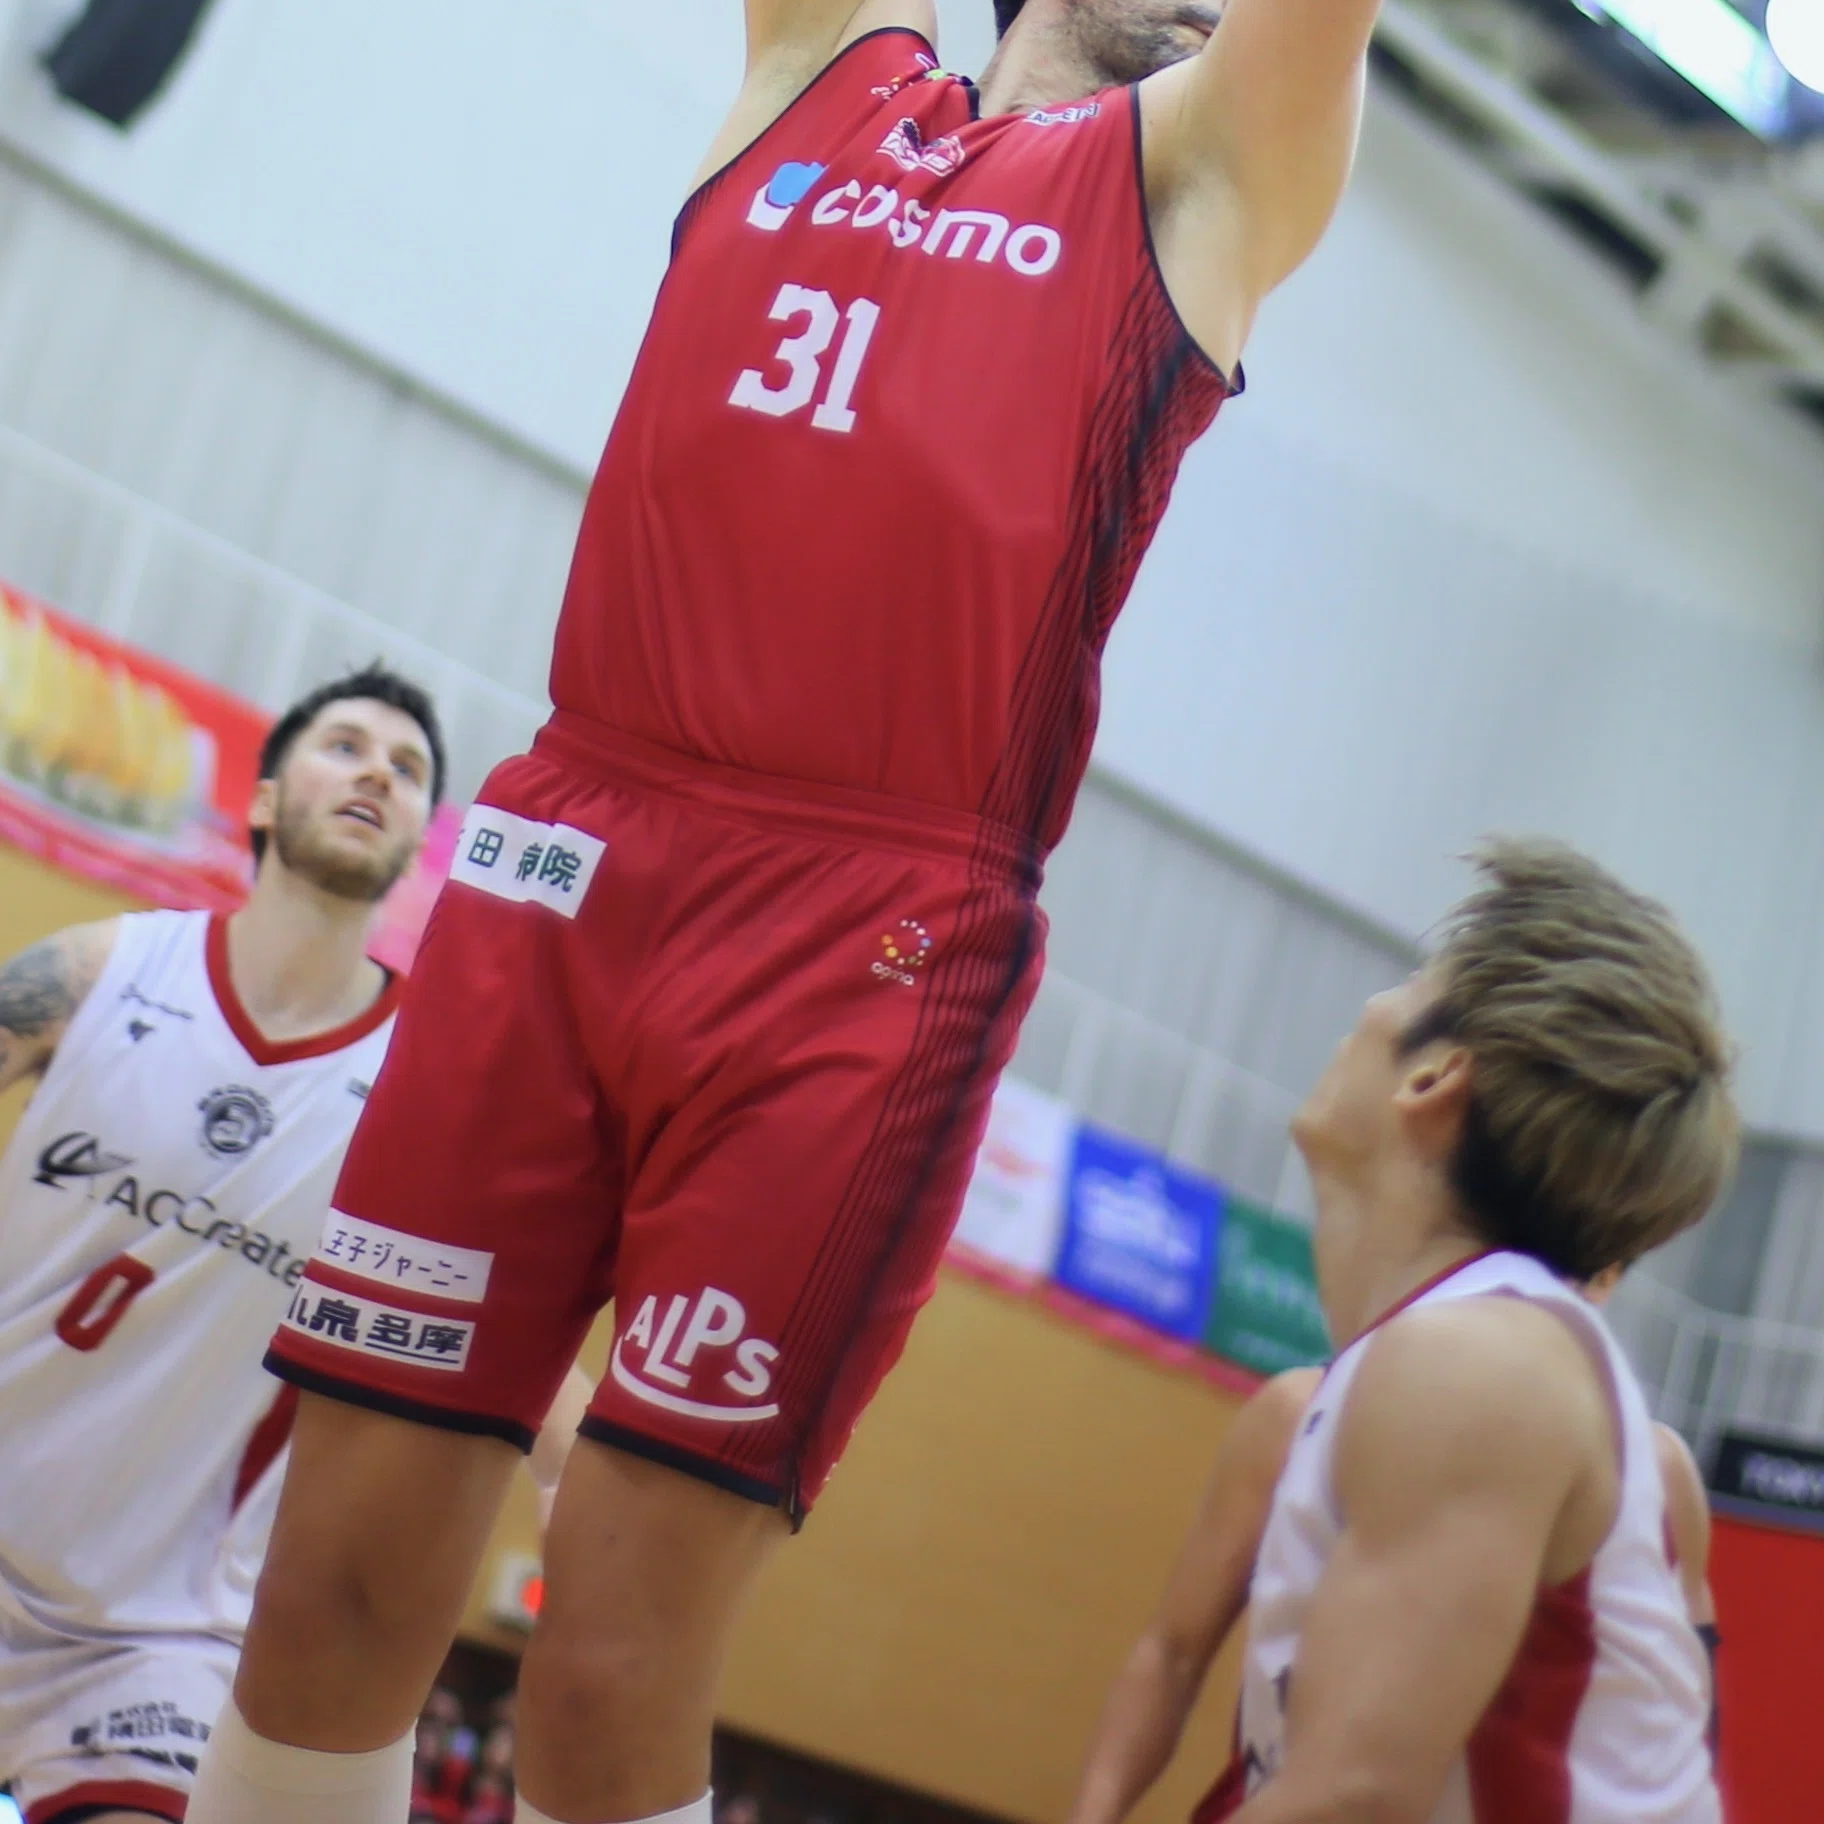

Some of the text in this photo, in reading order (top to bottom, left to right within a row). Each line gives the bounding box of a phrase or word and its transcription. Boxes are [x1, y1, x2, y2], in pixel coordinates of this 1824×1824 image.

[811, 179, 1062, 276] cosmo
[727, 282, 881, 434] 31
[457, 828, 583, 893] 田病院
[53, 1252, 157, 1353] 0
[319, 1229, 469, 1287] 王子ジャーニー
